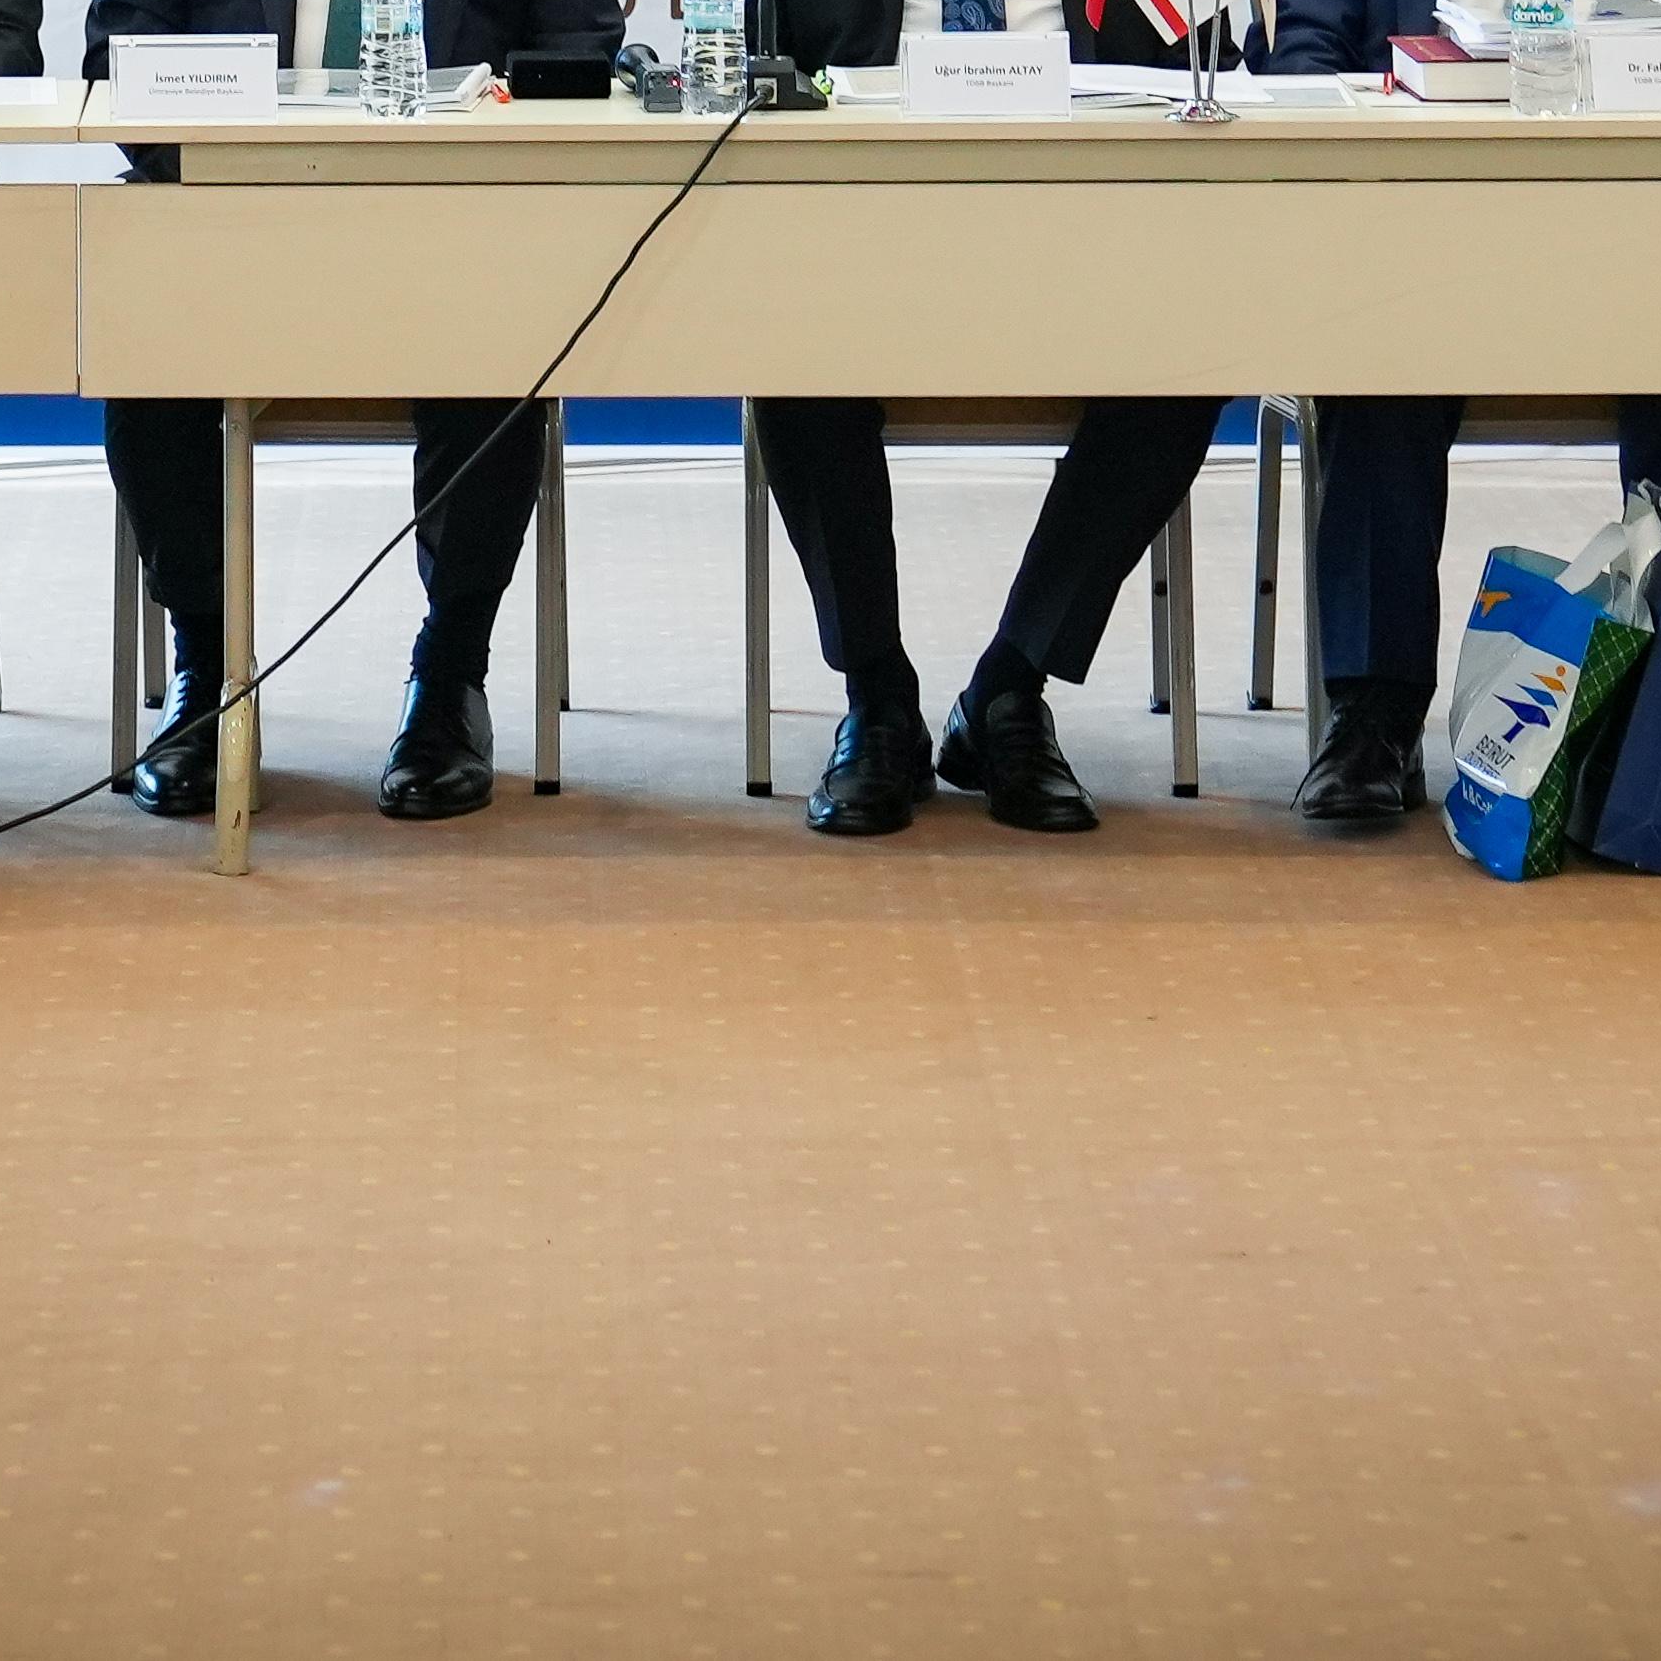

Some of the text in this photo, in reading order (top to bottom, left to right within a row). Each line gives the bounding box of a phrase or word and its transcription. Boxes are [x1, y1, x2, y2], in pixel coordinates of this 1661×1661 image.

[1514, 7, 1555, 23] damla
[935, 63, 1043, 77] Uğur İbrahim ALTAY
[1628, 63, 1644, 73] Dr.
[155, 71, 238, 84] İsmet YILDIRIM
